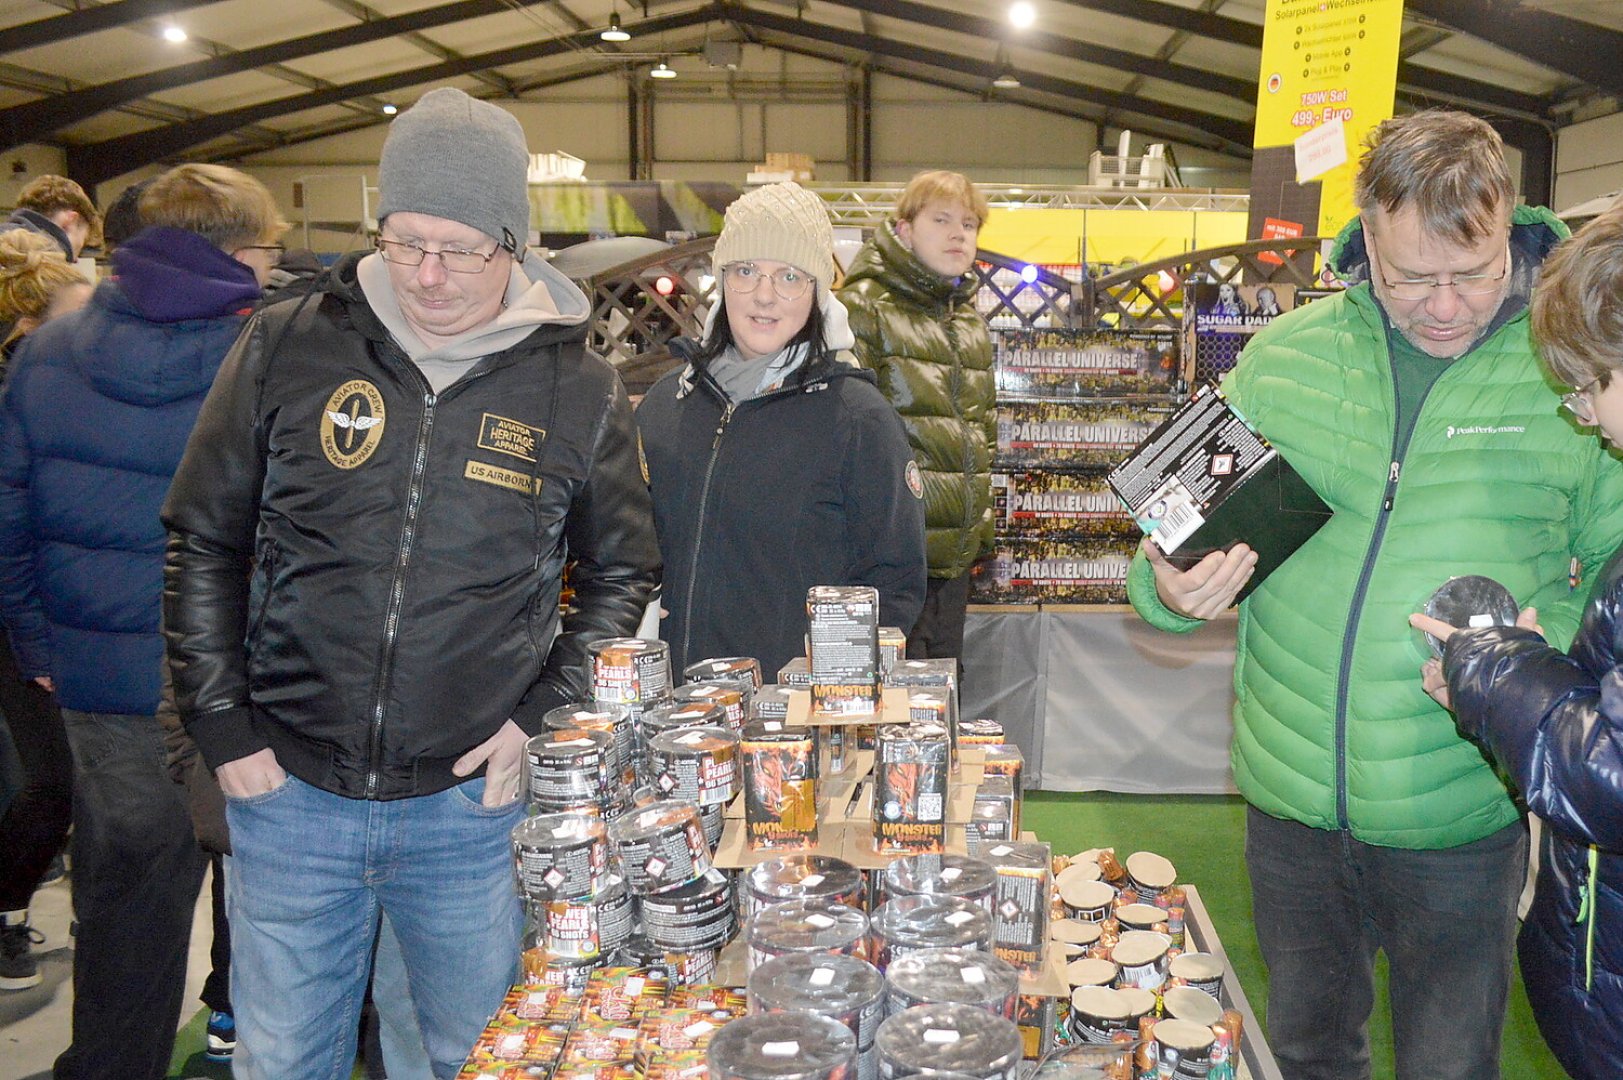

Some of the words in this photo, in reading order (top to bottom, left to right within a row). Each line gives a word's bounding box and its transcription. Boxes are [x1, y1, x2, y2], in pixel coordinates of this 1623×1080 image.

[1329, 88, 1347, 103] Set
[1322, 106, 1353, 124] Euro
[1197, 315, 1242, 325] SUGAR
[1244, 315, 1277, 326] DAD
[1003, 349, 1068, 368] PARALLEL
[1072, 351, 1138, 369] UNIVERSE
[333, 382, 367, 407] AVIATOR
[367, 388, 383, 413] CREW
[498, 420, 532, 437] AVIATOR
[1011, 423, 1083, 442] PARALLEL
[490, 427, 535, 452] HERITAGE
[494, 440, 529, 456] APPAREL
[325, 435, 348, 467] HERITAGE
[348, 440, 375, 467] APPAREL
[471, 465, 486, 476] US
[486, 470, 533, 489] AIRBORN
[1013, 492, 1082, 512] PARALLEL
[1011, 559, 1080, 579] PARALLEL
[600, 669, 631, 679] PEARLS
[814, 684, 873, 697] MONSTER
[881, 822, 943, 836] MONSTER
[551, 919, 590, 931] PEARLS
[560, 931, 589, 940] SHOTS
